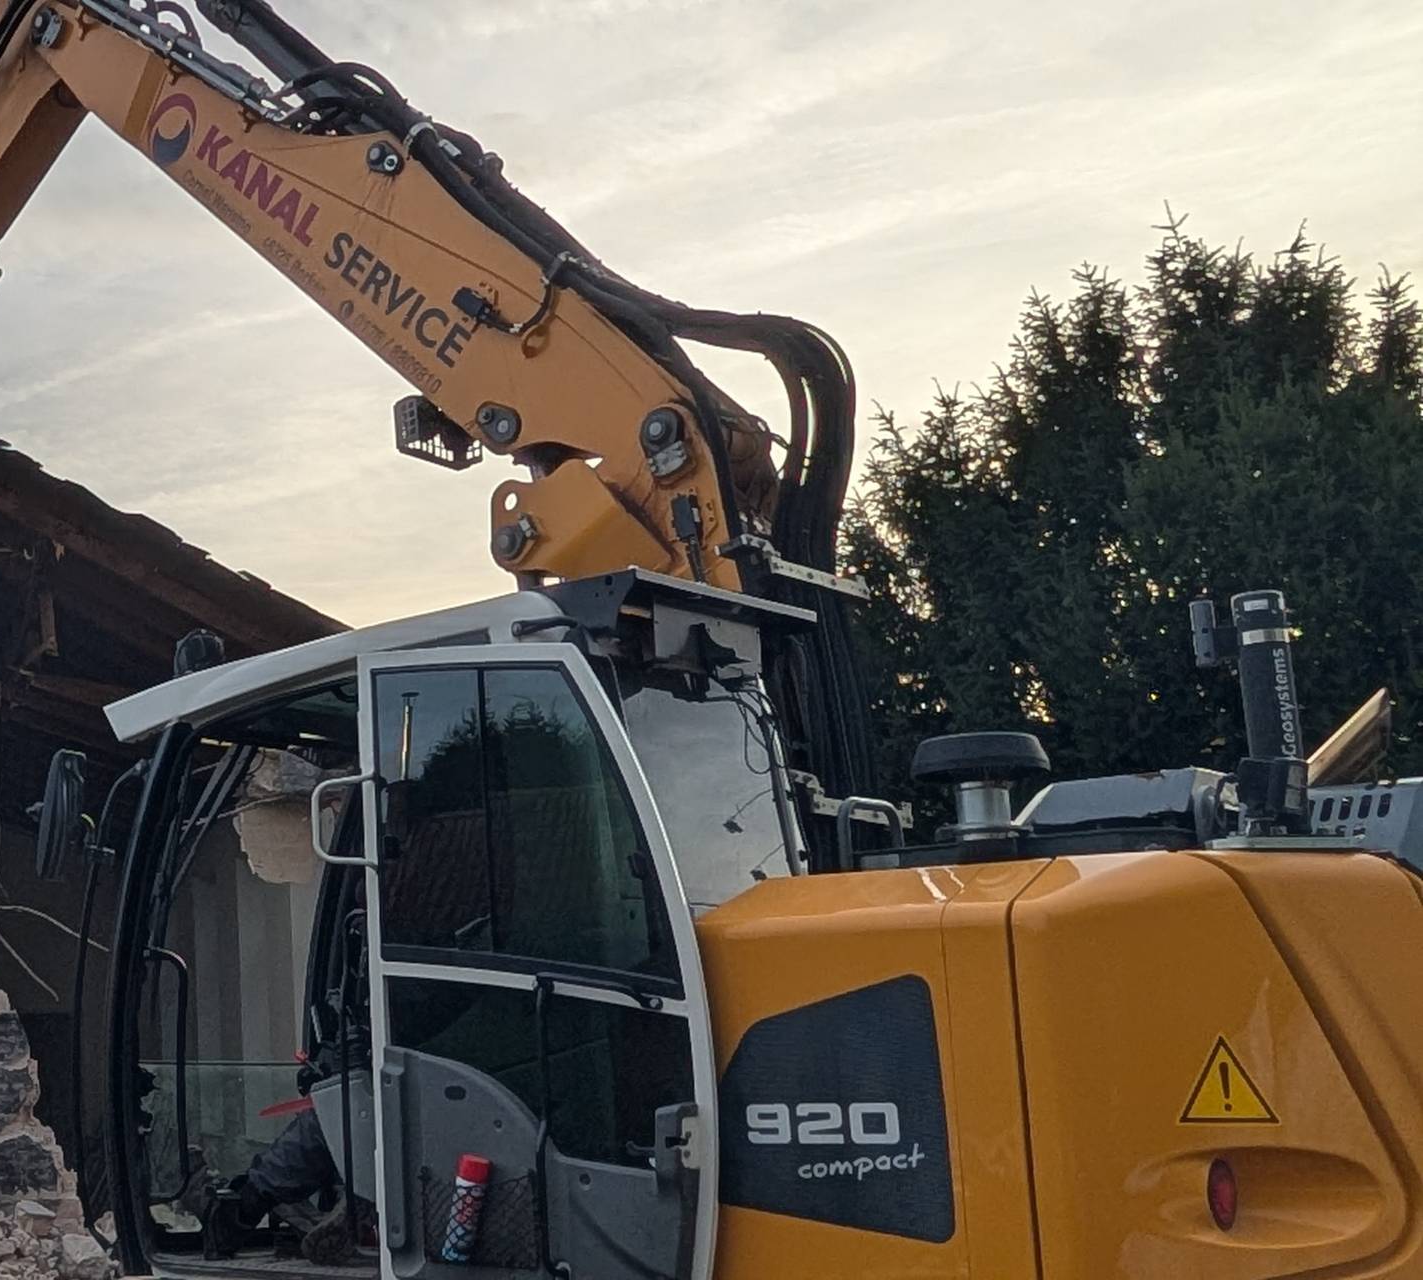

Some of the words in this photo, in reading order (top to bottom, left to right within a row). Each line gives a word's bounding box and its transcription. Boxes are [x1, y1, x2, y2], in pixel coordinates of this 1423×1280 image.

[196, 125, 320, 247] KANAL
[323, 232, 472, 368] SERVICE
[1273, 648, 1297, 758] Geosystems
[745, 1102, 901, 1145] 920
[797, 1143, 926, 1181] compact
